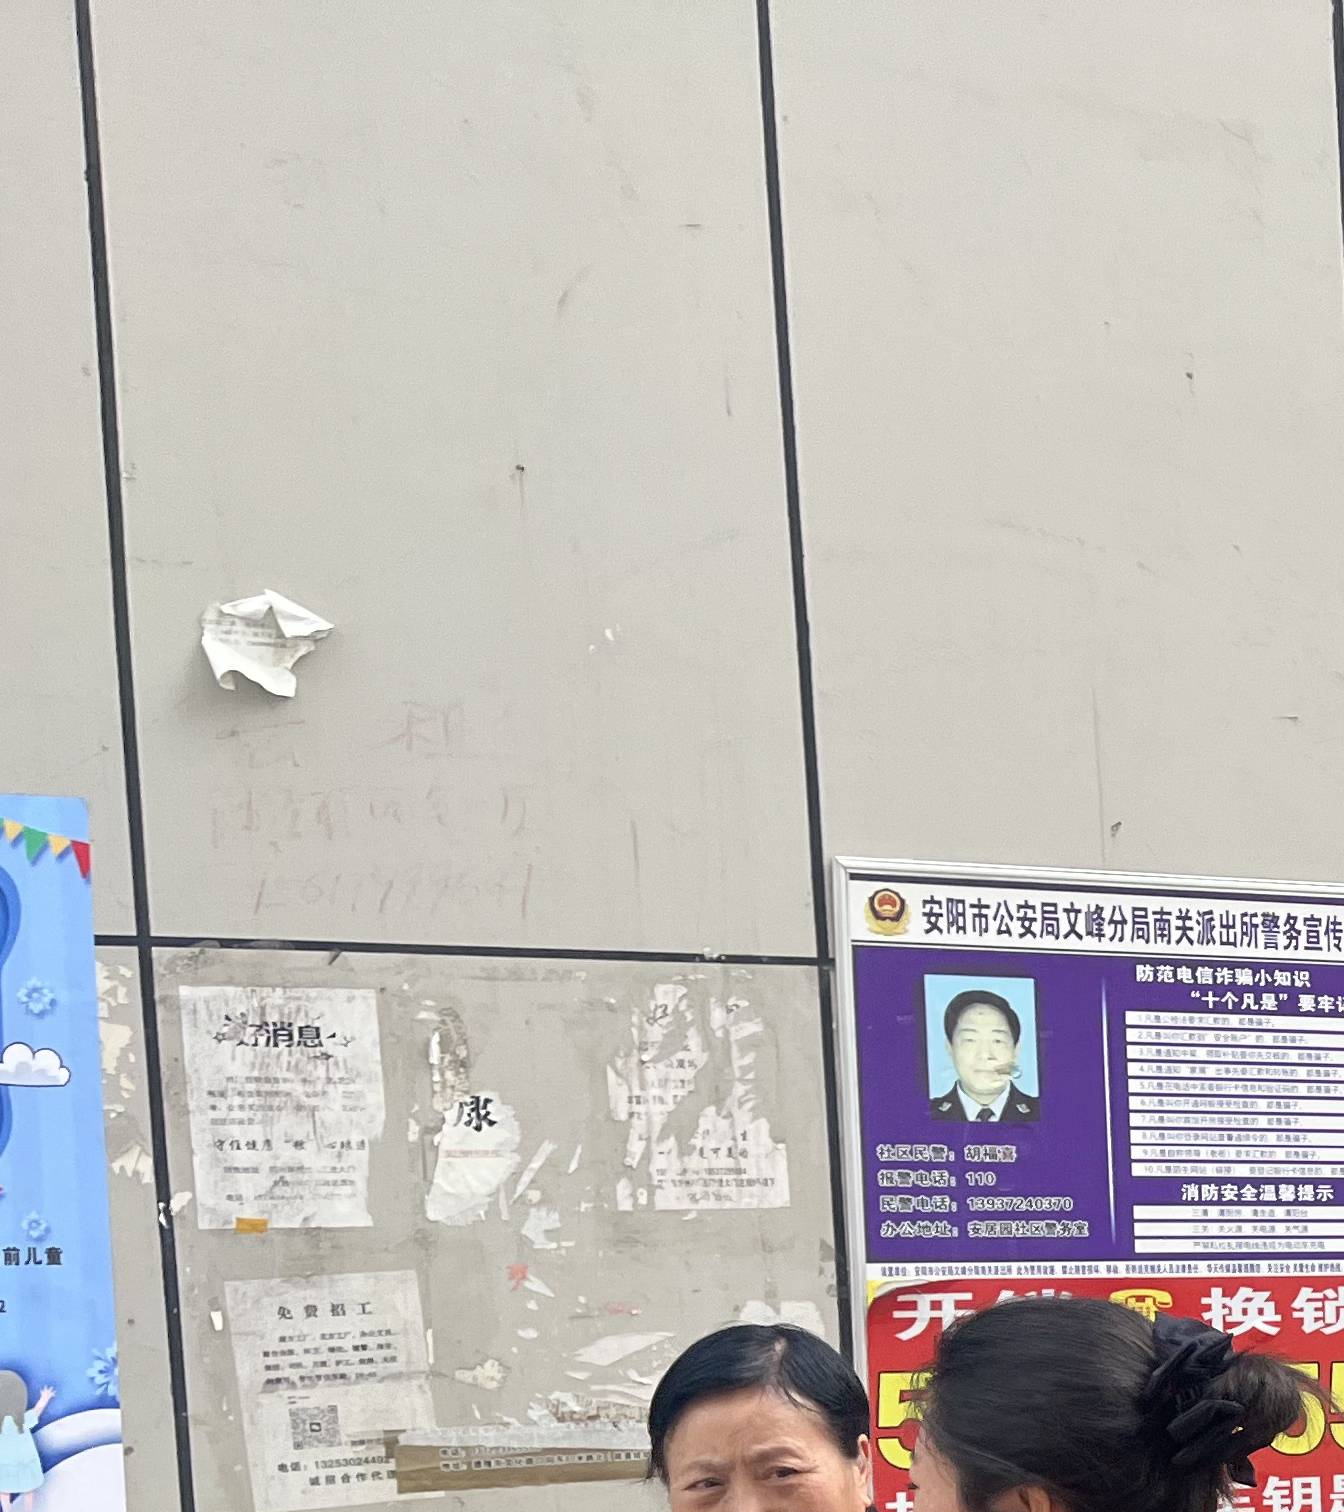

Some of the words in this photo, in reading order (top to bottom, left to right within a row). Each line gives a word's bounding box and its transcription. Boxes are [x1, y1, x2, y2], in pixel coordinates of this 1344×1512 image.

[1135, 964, 1311, 988] 防范电信诈骗小知识
[1181, 1183, 1335, 1202] 消防安全温馨提示
[2, 1246, 63, 1266] 前儿童
